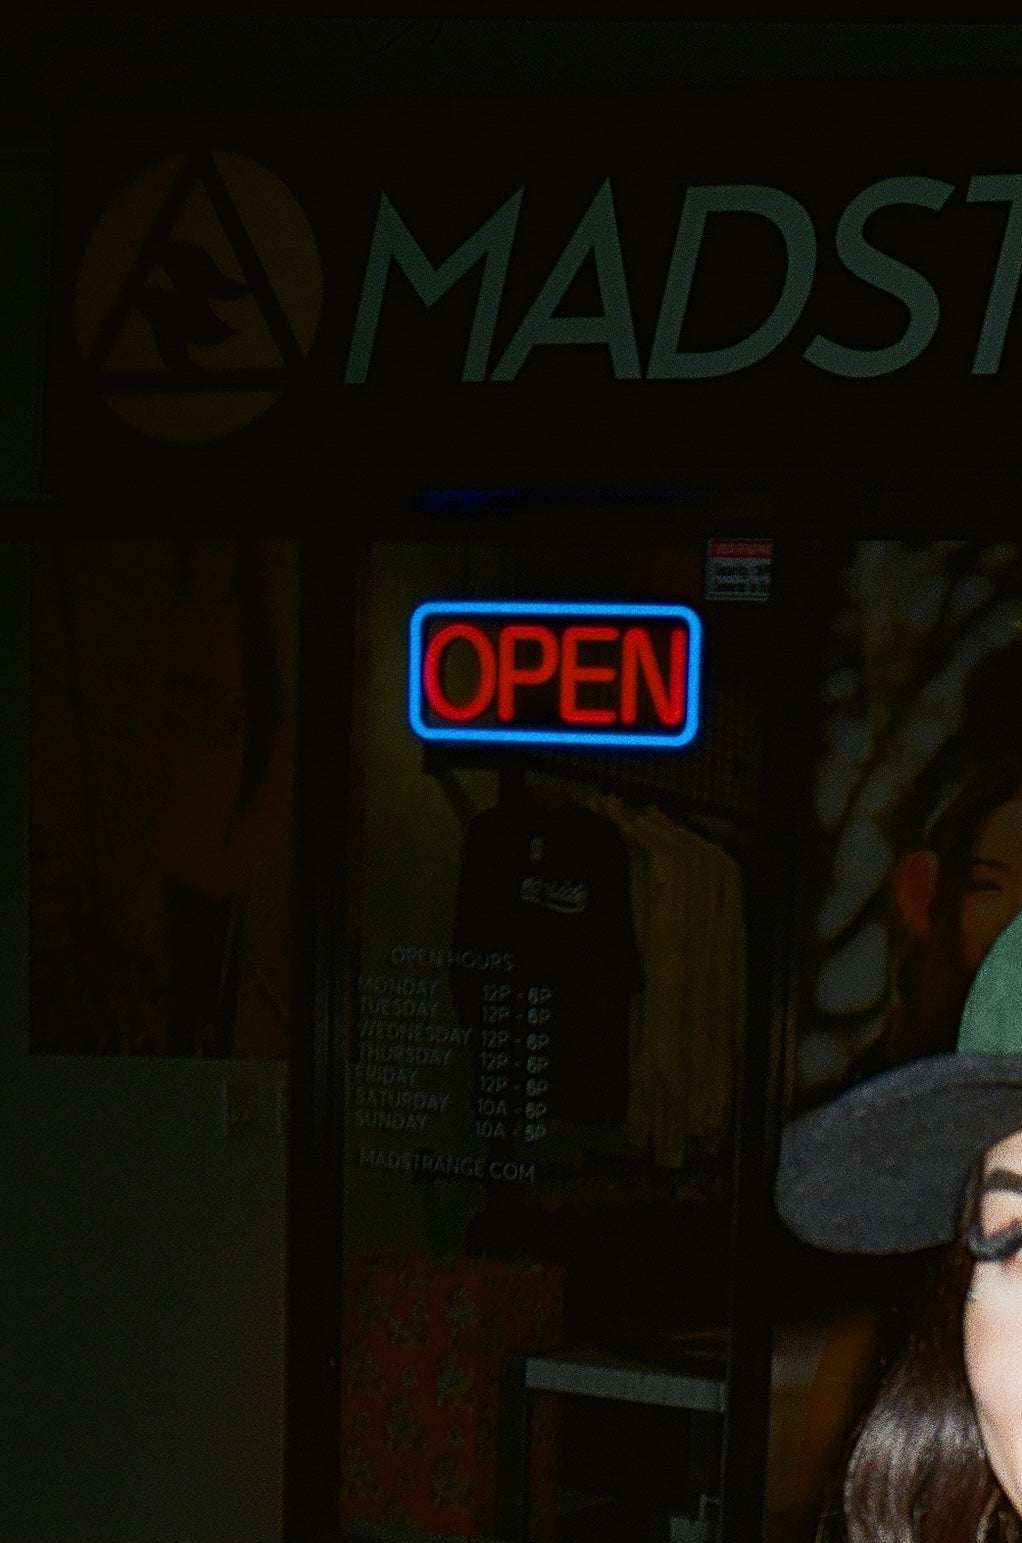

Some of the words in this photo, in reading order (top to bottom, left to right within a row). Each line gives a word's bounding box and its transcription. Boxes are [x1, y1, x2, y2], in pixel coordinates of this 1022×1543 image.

[423, 623, 687, 727] OPEN
[391, 946, 444, 967] OPEN
[447, 949, 515, 972] HOURS
[358, 976, 439, 996] MONDAY
[482, 984, 511, 1002] 12P
[359, 997, 440, 1018] TUESDAY
[482, 1005, 511, 1023] 12P
[359, 1020, 473, 1046] WEDNESDAY
[481, 1029, 510, 1048] 12P
[359, 1043, 453, 1066] THURSDAY
[480, 1052, 509, 1070] 12P
[354, 1065, 419, 1086] FRIDAY
[479, 1075, 509, 1093] 12P
[354, 1087, 451, 1112] SATURDAY
[476, 1098, 508, 1116] 10A
[354, 1109, 429, 1131] SUNDAY
[475, 1121, 507, 1139] 10A
[358, 1148, 536, 1181] MADSTRANGE.COM
